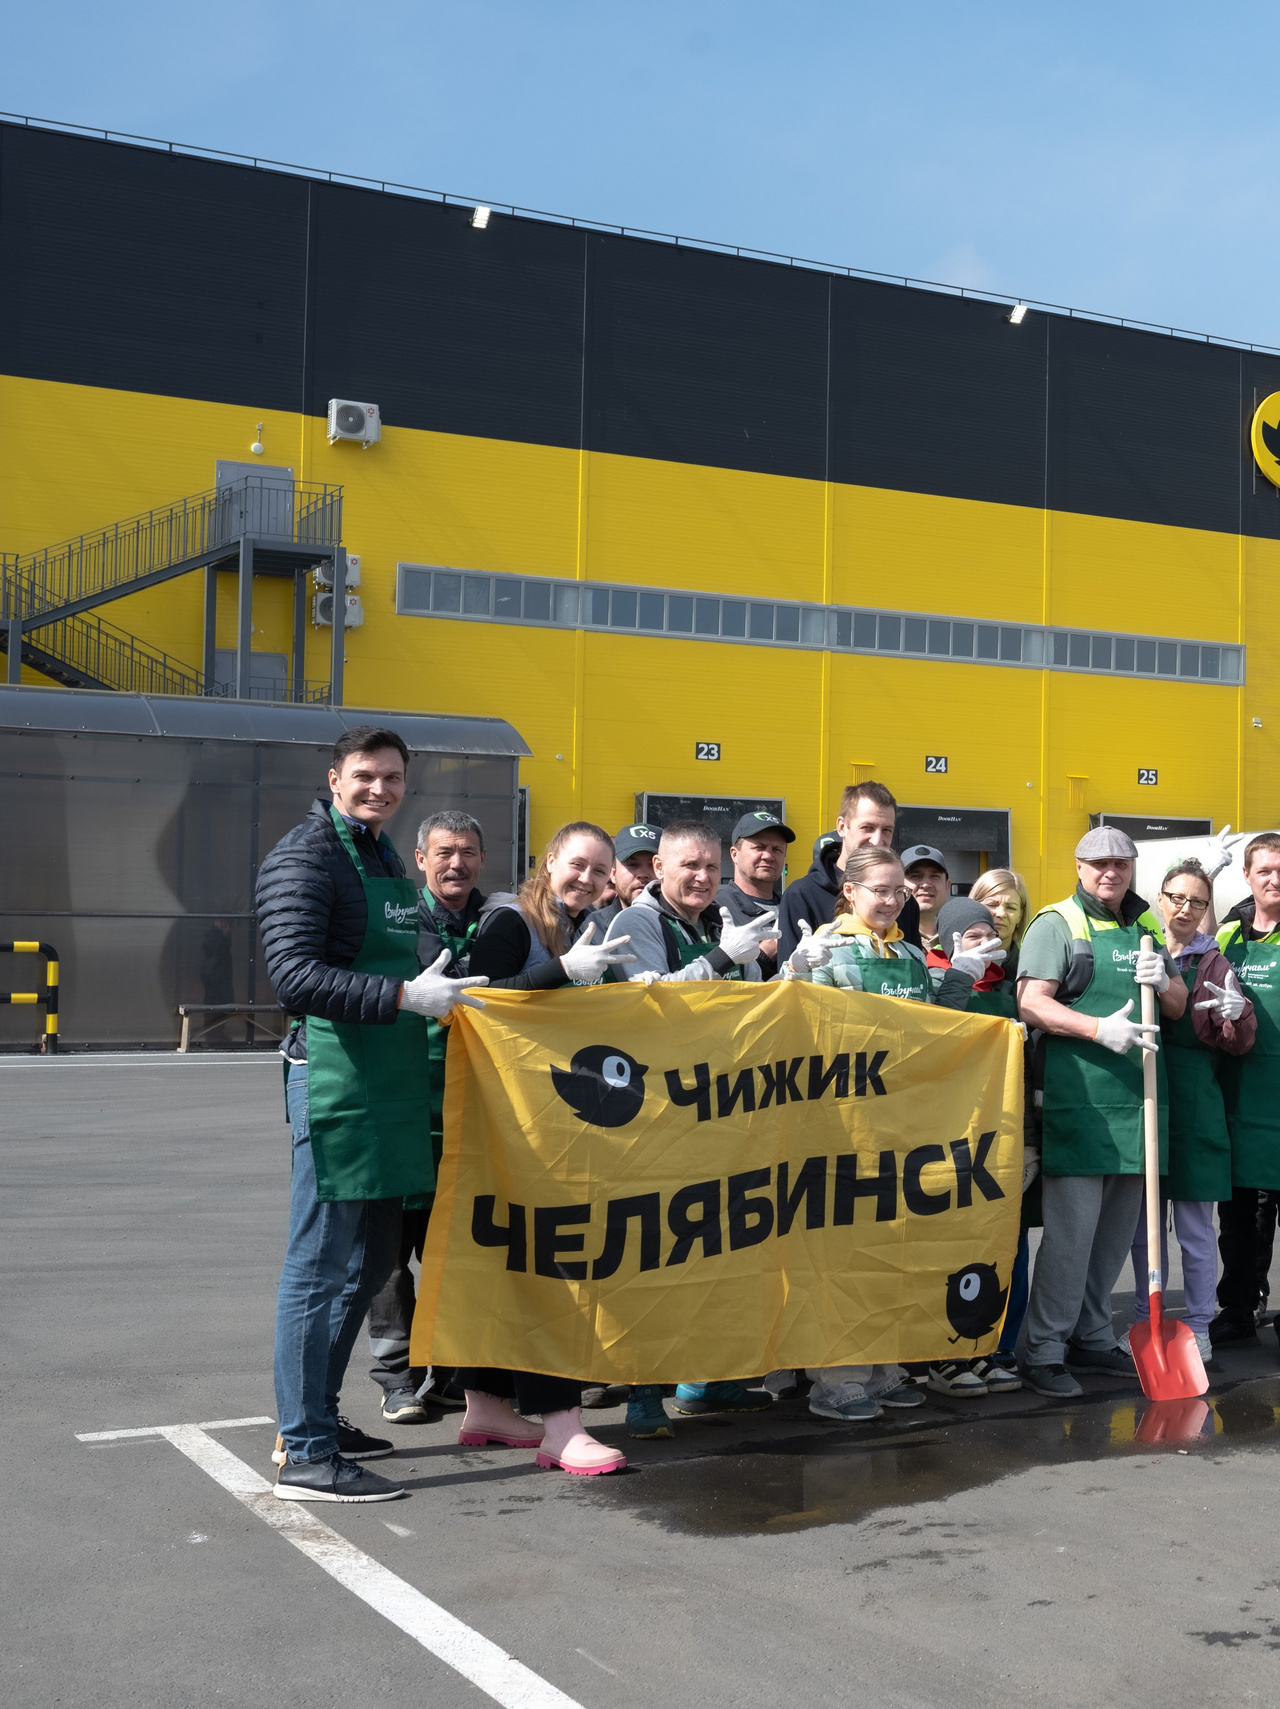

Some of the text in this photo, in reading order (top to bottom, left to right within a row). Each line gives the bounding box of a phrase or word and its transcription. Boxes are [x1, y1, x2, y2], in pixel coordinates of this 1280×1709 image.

[698, 743, 719, 760] 23
[926, 756, 947, 773] 24
[1139, 769, 1157, 785] 25
[639, 830, 656, 840] X5
[664, 1050, 890, 1122] Чижик
[470, 1130, 1007, 1281] ЧЕЛЯБИНСК
